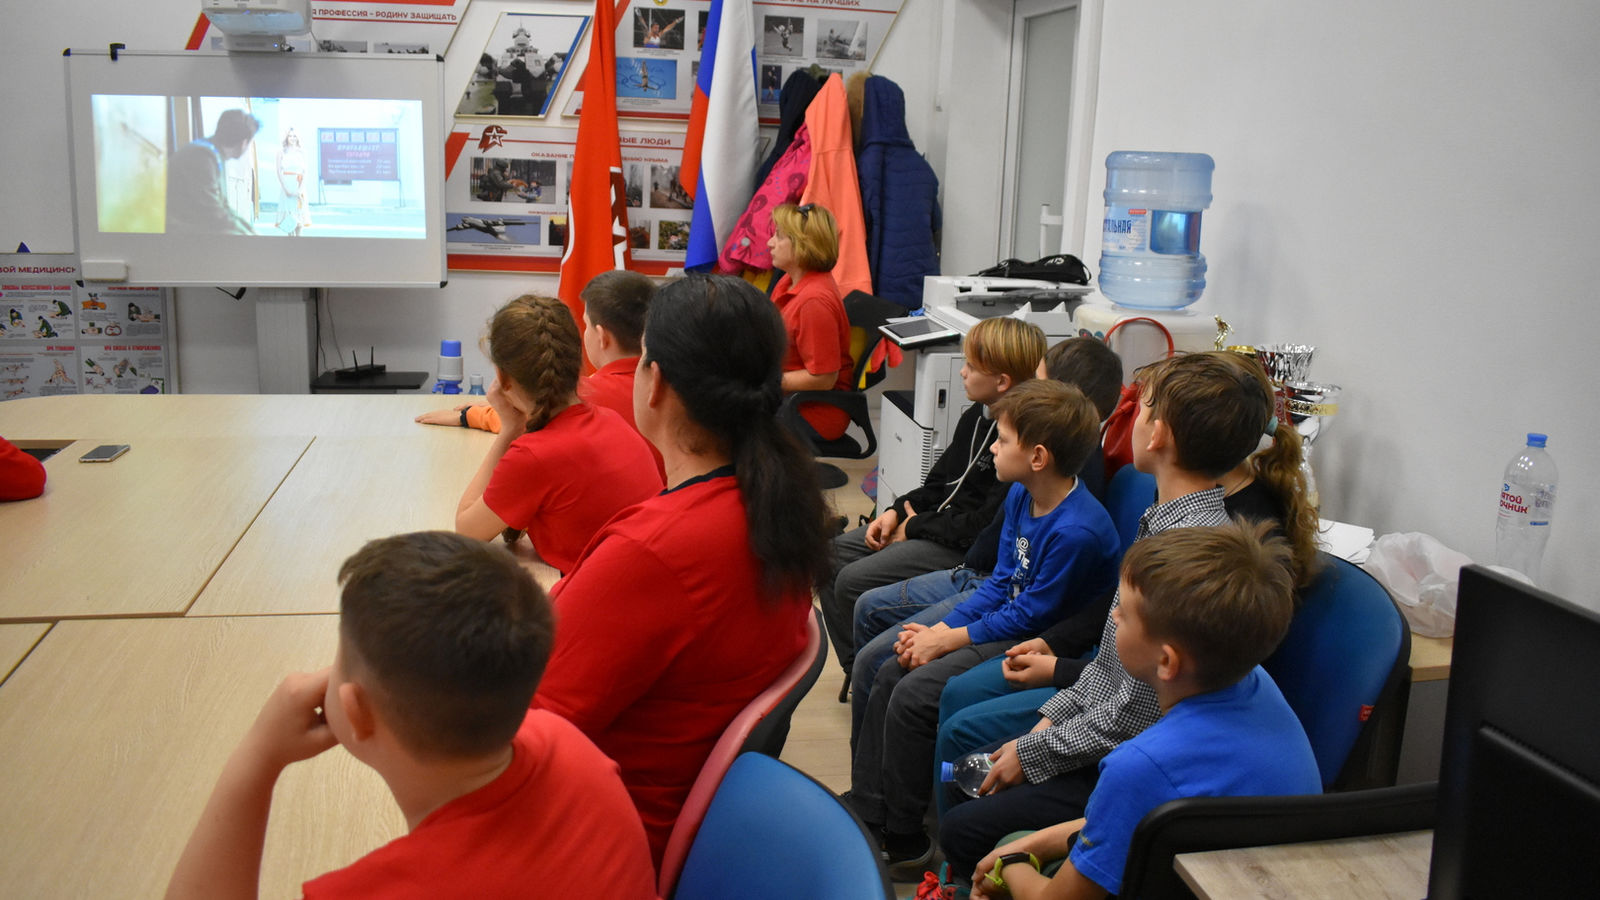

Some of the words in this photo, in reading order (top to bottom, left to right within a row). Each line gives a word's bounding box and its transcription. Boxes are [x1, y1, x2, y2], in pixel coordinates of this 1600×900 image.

[318, 8, 369, 17] ПРОФЕССИЯ
[375, 11, 408, 19] РОДИНУ
[410, 12, 457, 21] ЗАЩИЩАТЬ
[640, 137, 671, 146] ЛЮДИ
